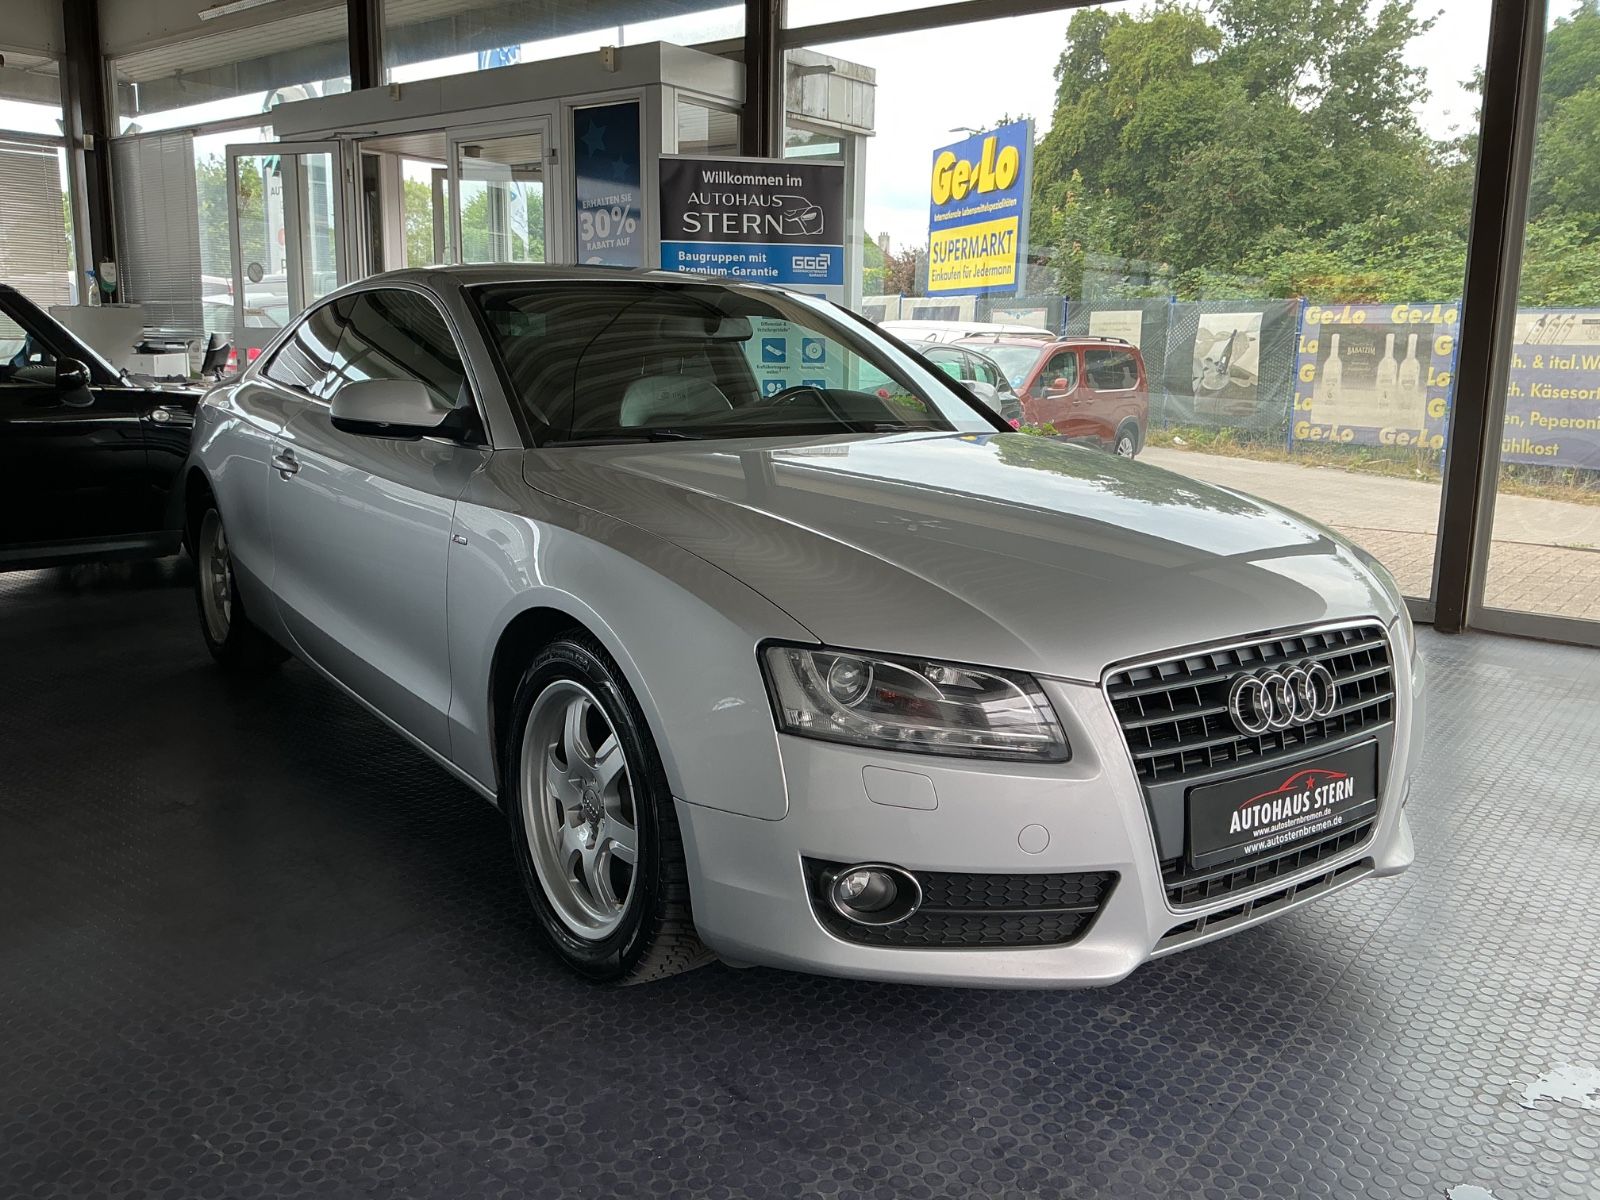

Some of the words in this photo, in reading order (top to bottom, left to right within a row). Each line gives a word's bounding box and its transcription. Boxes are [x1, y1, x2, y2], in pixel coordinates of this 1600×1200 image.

[701, 170, 783, 187] Willkommen
[786, 173, 803, 187] im
[582, 195, 620, 209] ERHALTEN
[620, 192, 632, 203] SIE
[687, 192, 783, 207] AUTOHAUS
[580, 203, 636, 241] 30%
[682, 211, 783, 235] STERN
[586, 239, 615, 251] RABATT
[616, 237, 631, 248] AUF
[932, 229, 1013, 264] SUPERMARKT
[678, 250, 746, 264] Baugruppen
[749, 252, 767, 263] mit
[678, 264, 779, 277] Premium-Garantie
[932, 266, 962, 282] Einkaufen
[962, 264, 972, 279] für
[972, 263, 1012, 278] Jedermann
[1511, 353, 1527, 369] h.
[1532, 354, 1544, 369] &
[1229, 791, 1310, 834] AUTOHAUS
[1314, 777, 1354, 809] STERN
[1253, 807, 1331, 838] www.autosternbremen.de
[1244, 815, 1343, 854] www.autosternbremen.de
